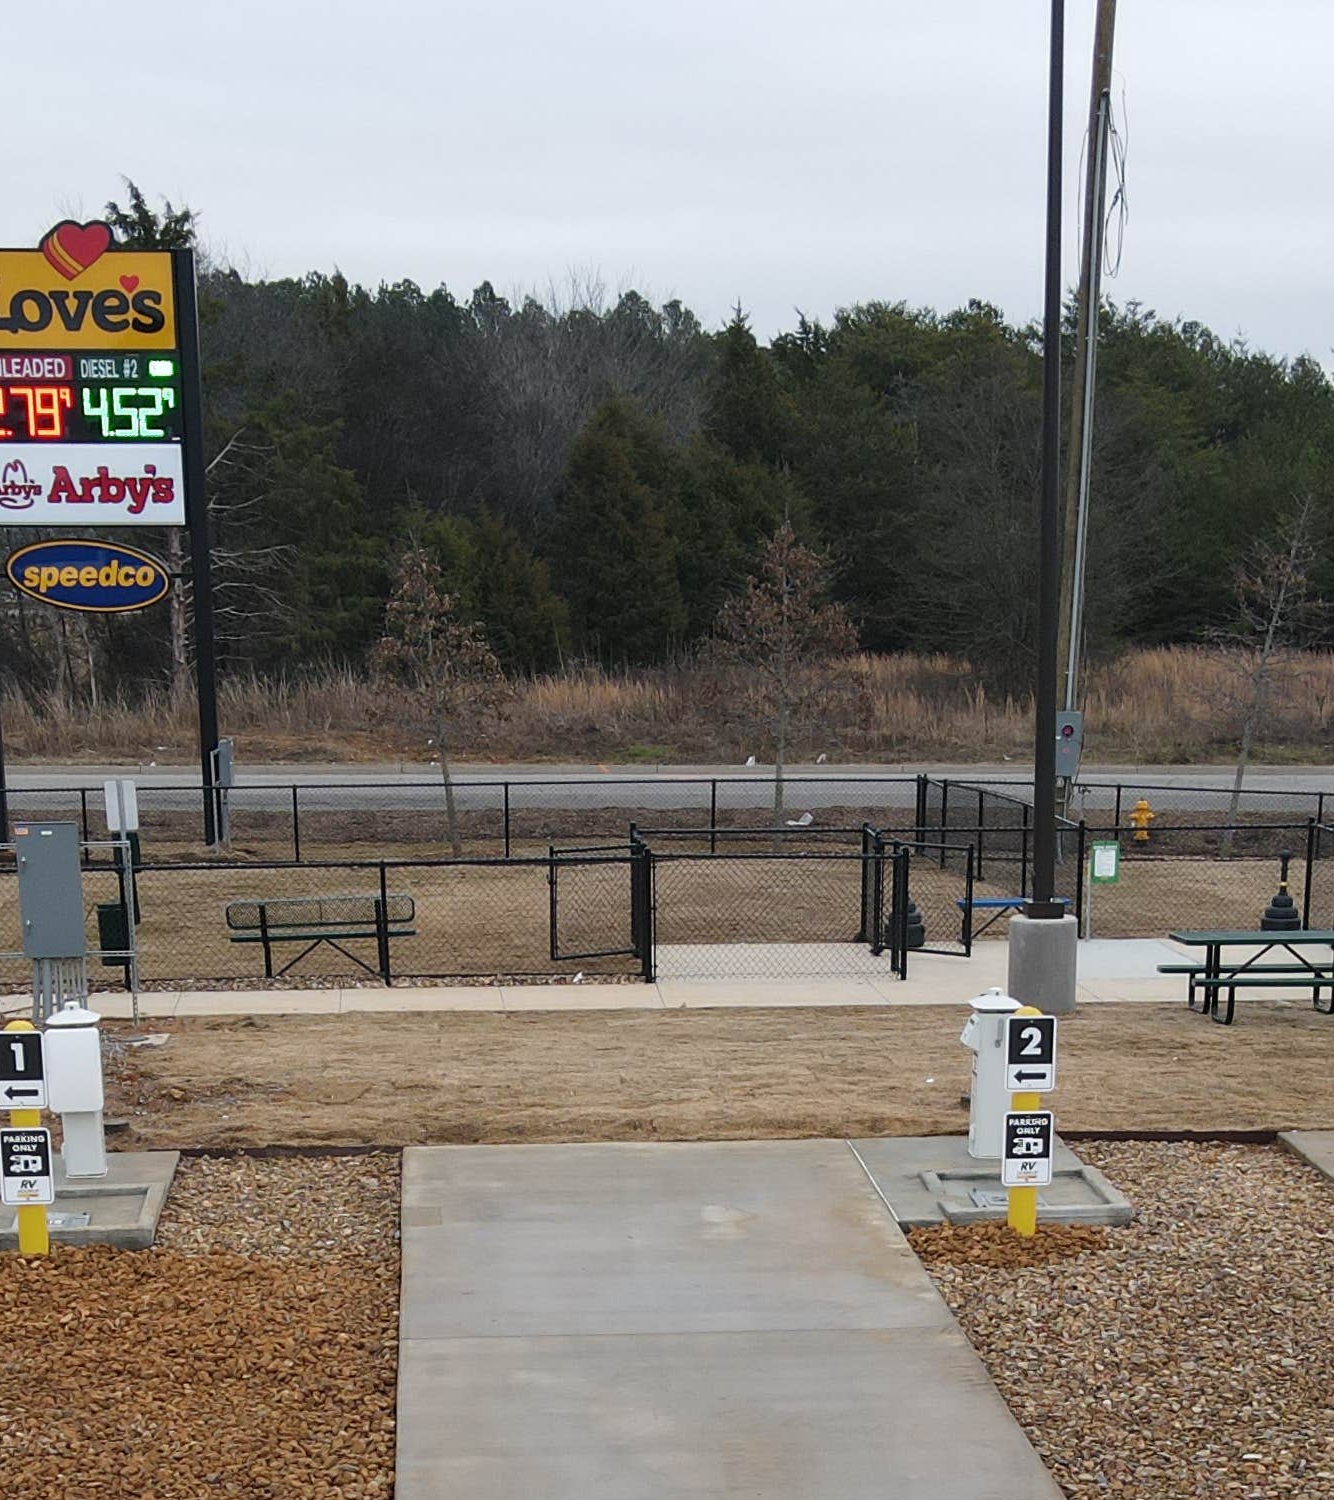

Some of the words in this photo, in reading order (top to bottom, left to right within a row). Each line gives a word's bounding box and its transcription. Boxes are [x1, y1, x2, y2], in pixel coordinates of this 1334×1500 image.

[80, 359, 119, 378] DIESEL
[123, 359, 138, 378] #2
[47, 464, 175, 514] Arby's
[23, 559, 155, 593] speedco
[1020, 1027, 1042, 1055] 2
[10, 1043, 25, 1071] 1
[1009, 1118, 1048, 1126] PARKING
[1016, 1127, 1041, 1135] ONLY
[3, 1135, 45, 1144] PARKING
[12, 1144, 38, 1153] ONLY
[1021, 1161, 1036, 1171] RV
[20, 1179, 36, 1189] RV
